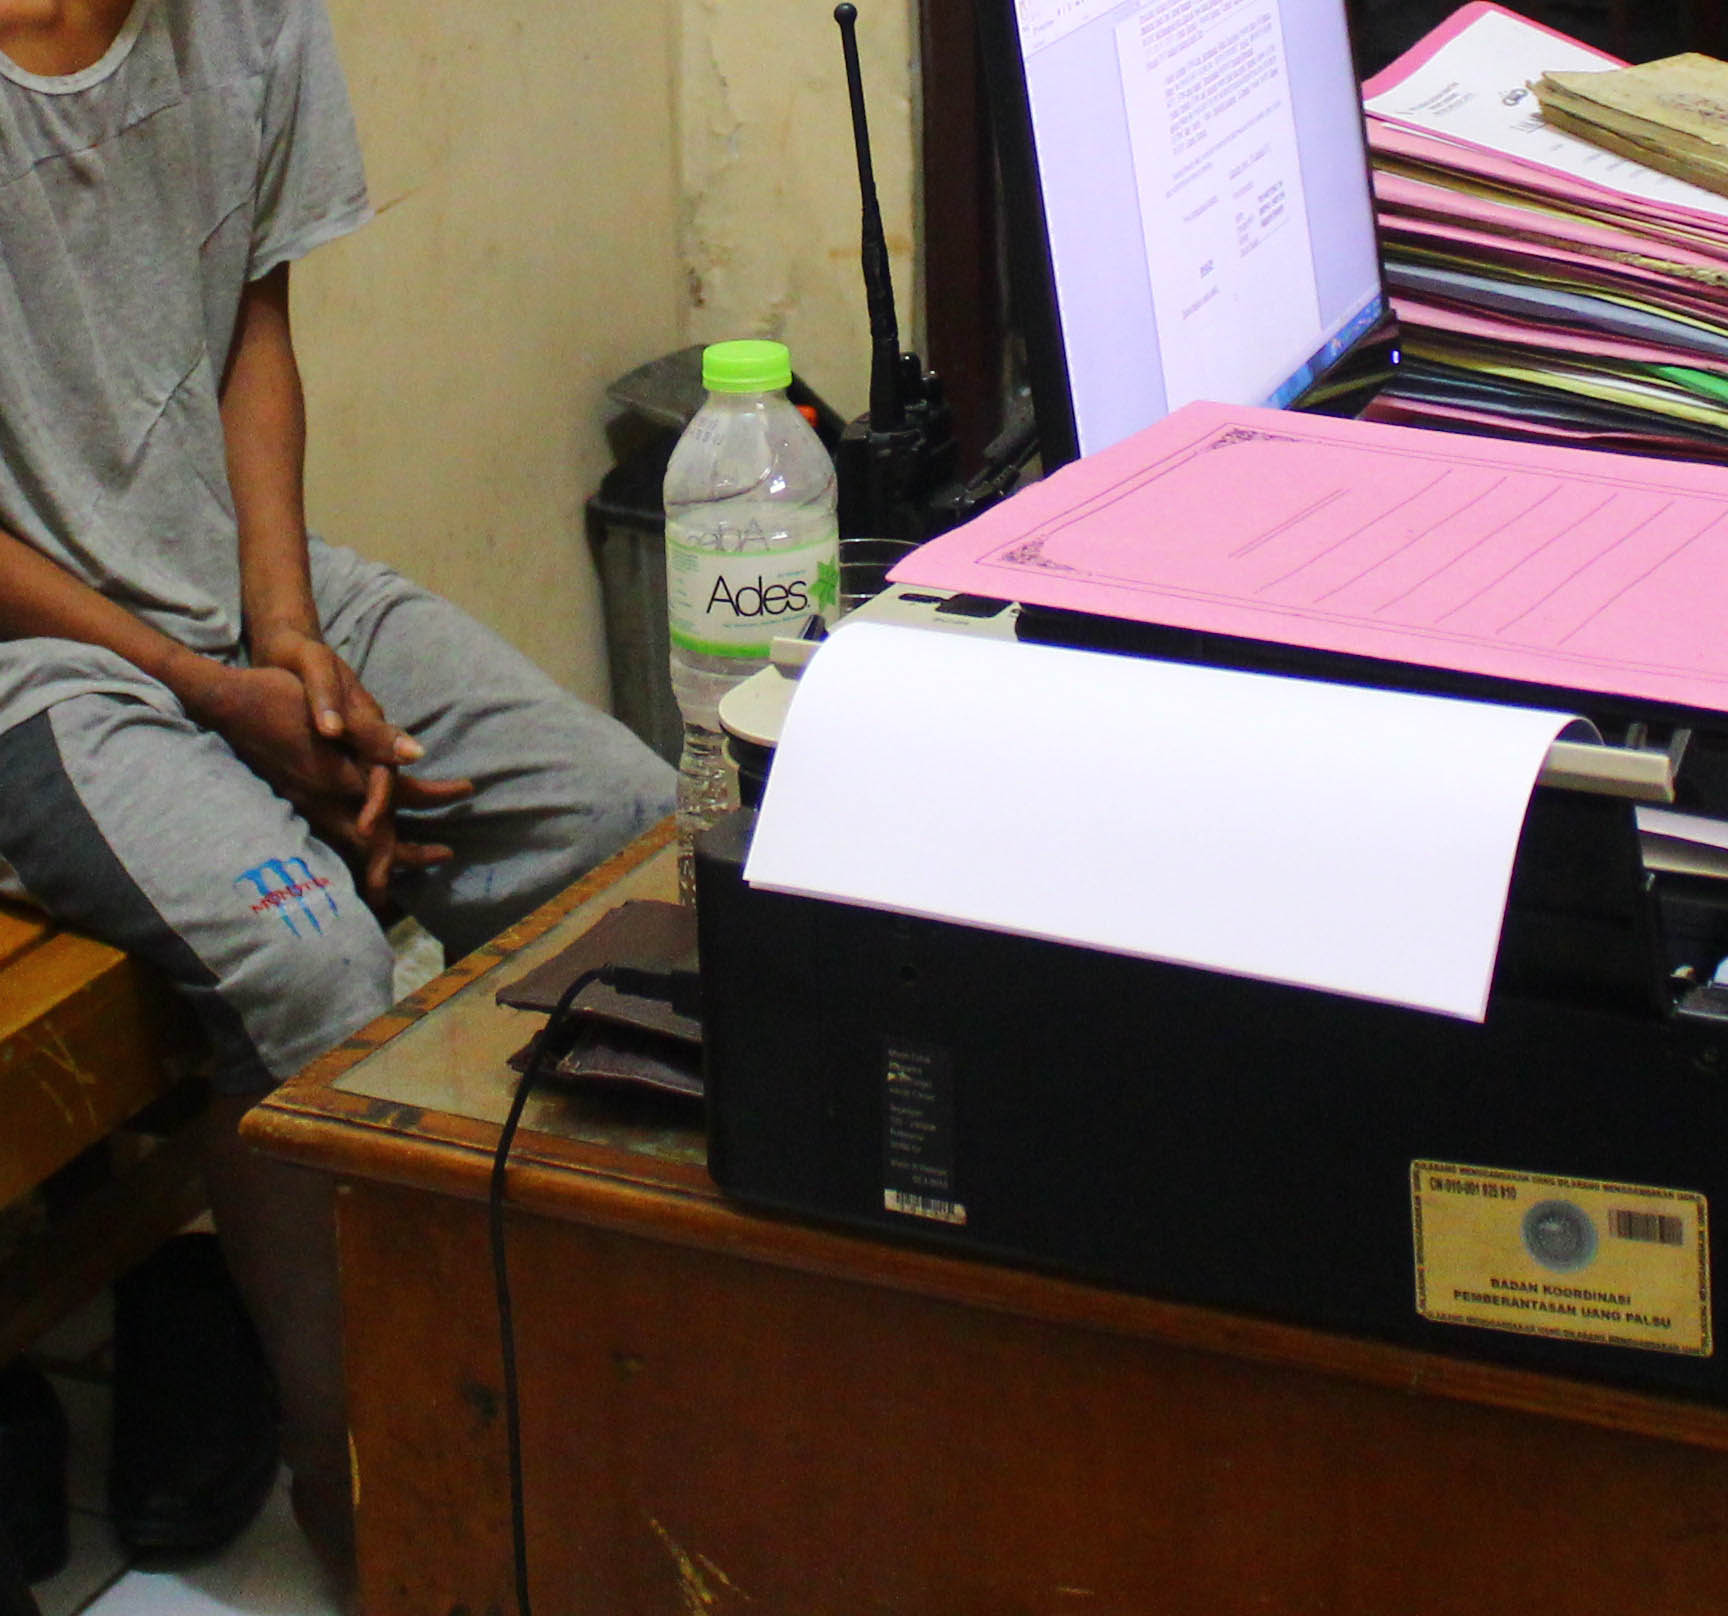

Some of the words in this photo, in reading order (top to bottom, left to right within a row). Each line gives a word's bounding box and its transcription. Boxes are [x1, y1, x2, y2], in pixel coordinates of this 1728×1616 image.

[1453, 1289, 1577, 1317] PEMBERANTASAN
[1581, 1304, 1621, 1323] UANG
[1625, 1311, 1671, 1330] PALSU
[1489, 1278, 1539, 1294] BADAN
[1542, 1283, 1632, 1307] KOORDINASI
